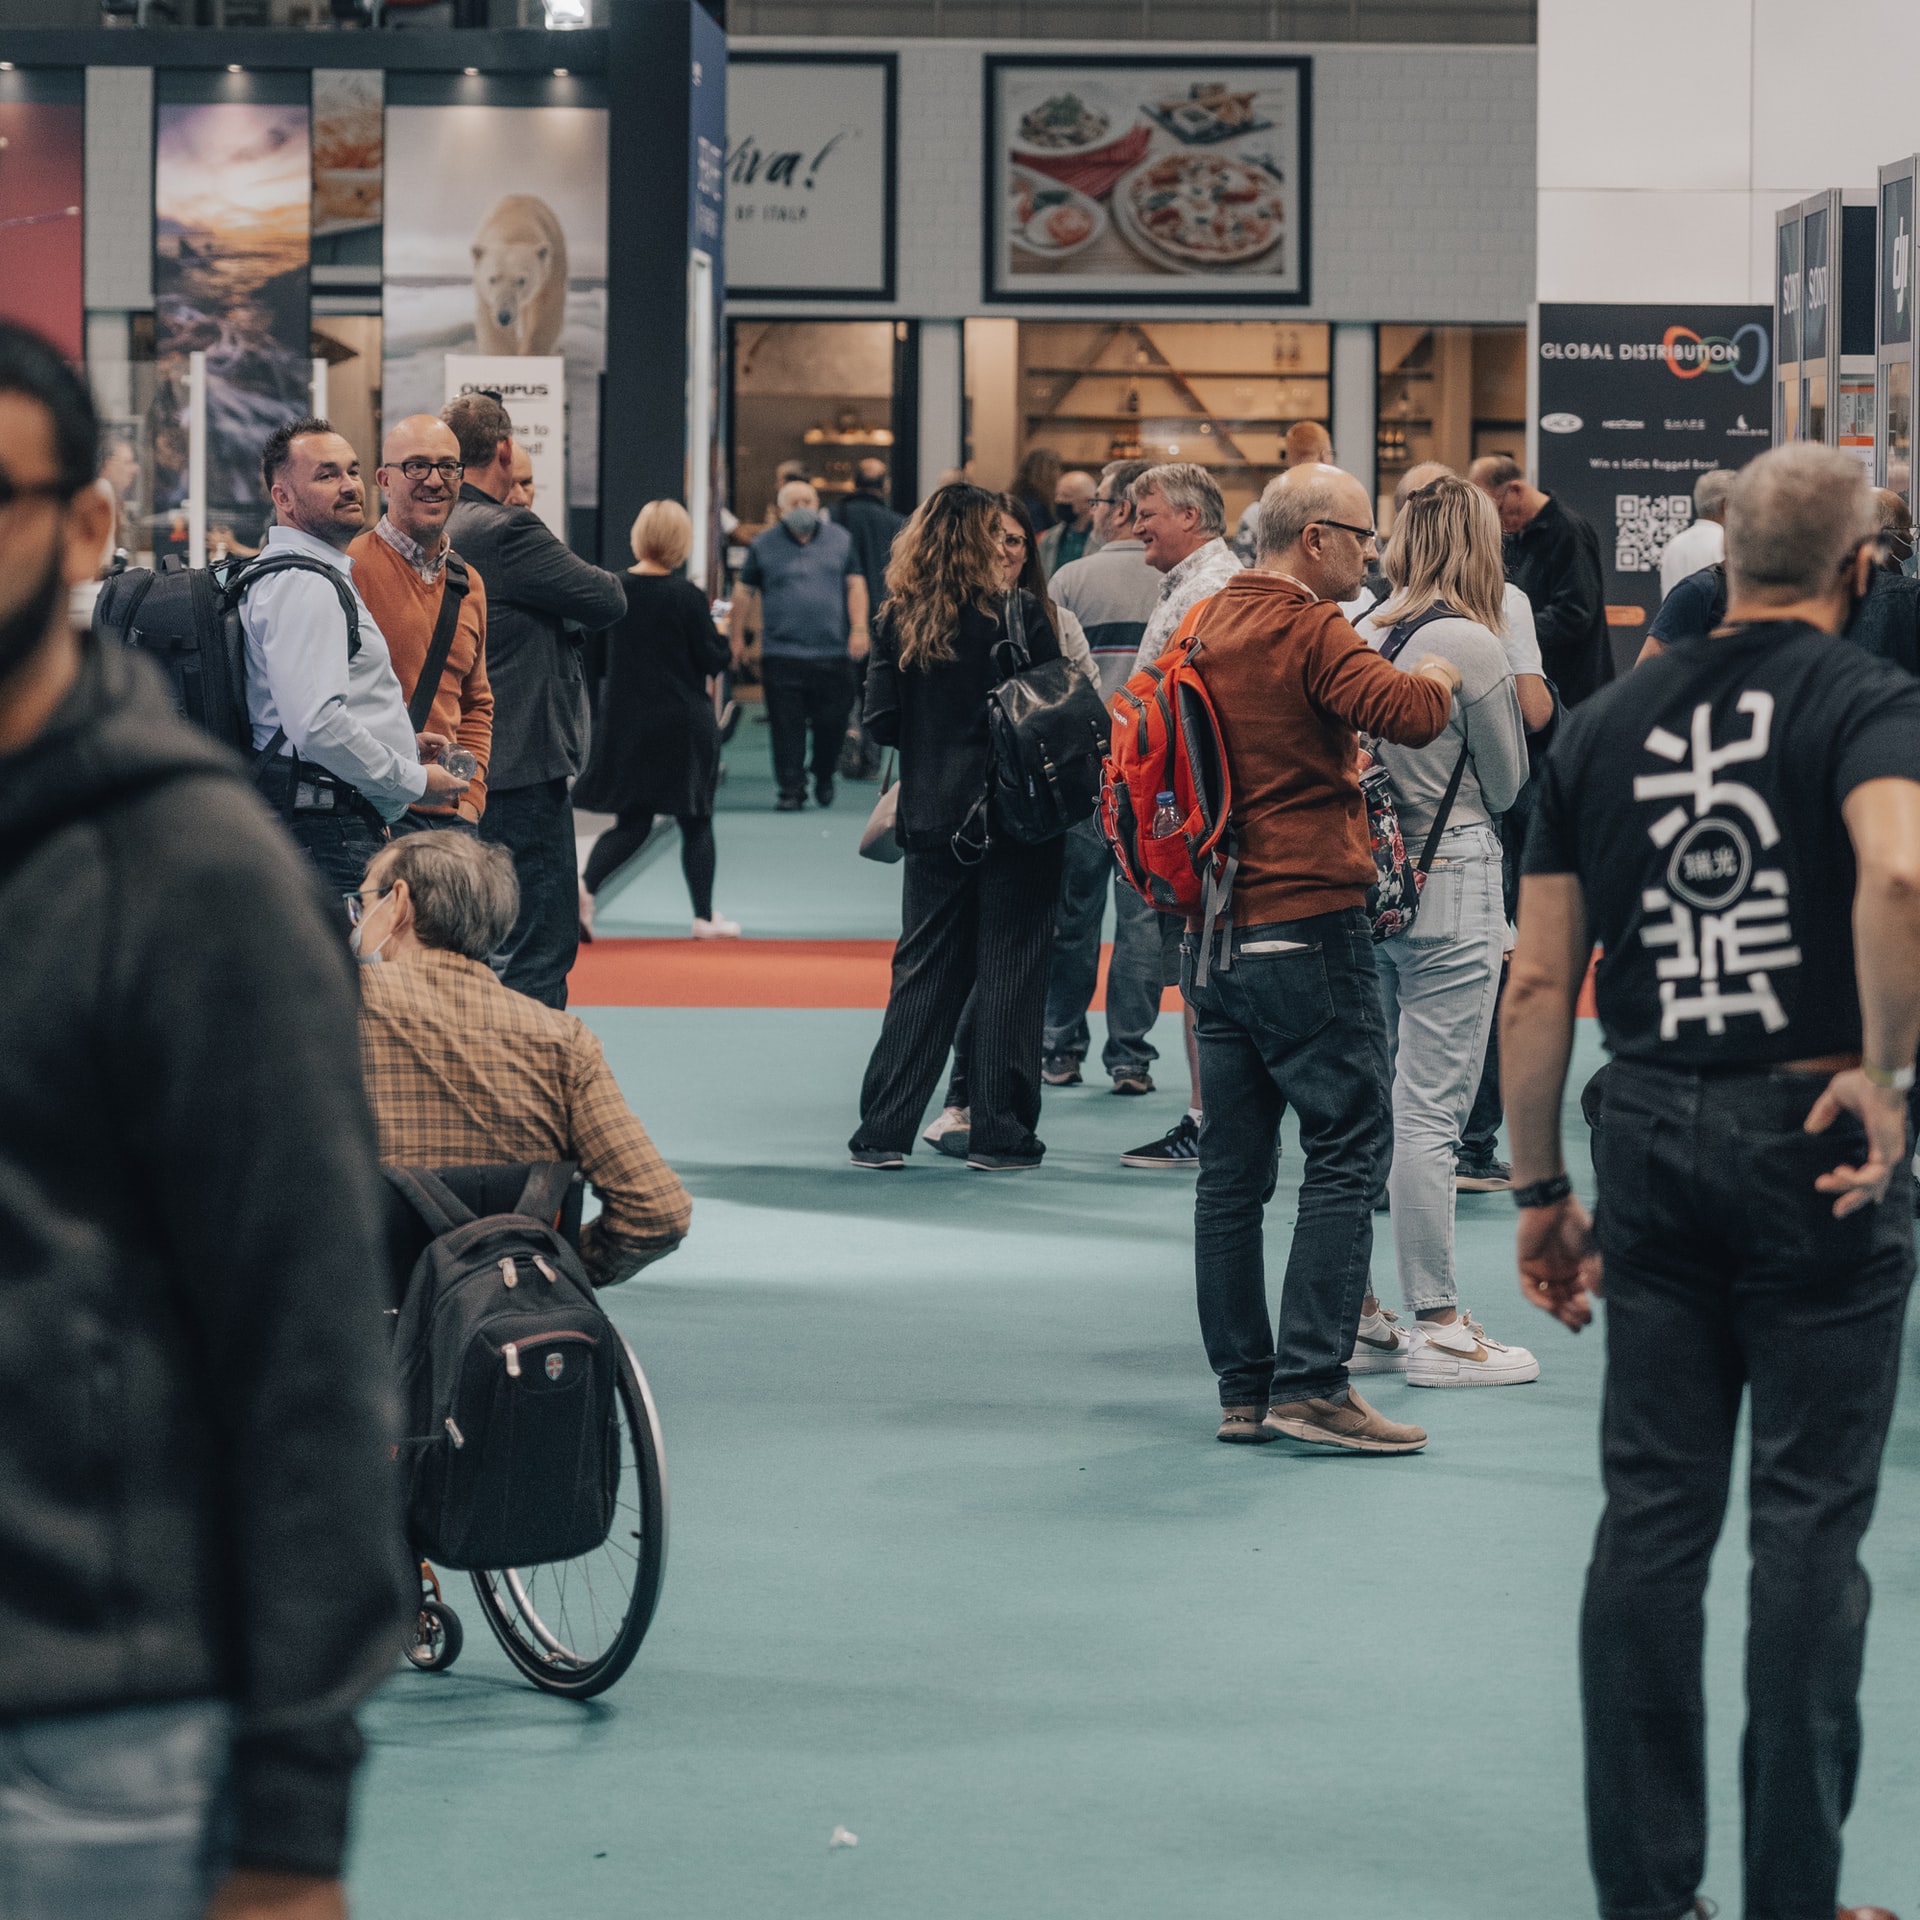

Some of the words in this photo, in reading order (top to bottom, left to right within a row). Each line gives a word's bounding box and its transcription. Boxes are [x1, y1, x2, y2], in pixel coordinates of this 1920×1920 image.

[1540, 342, 1614, 360] GLOBAL
[1619, 343, 1740, 361] DISTRIBUTION
[460, 383, 549, 396] OLYMPUS
[534, 423, 548, 435] to
[1589, 458, 1610, 469] Win
